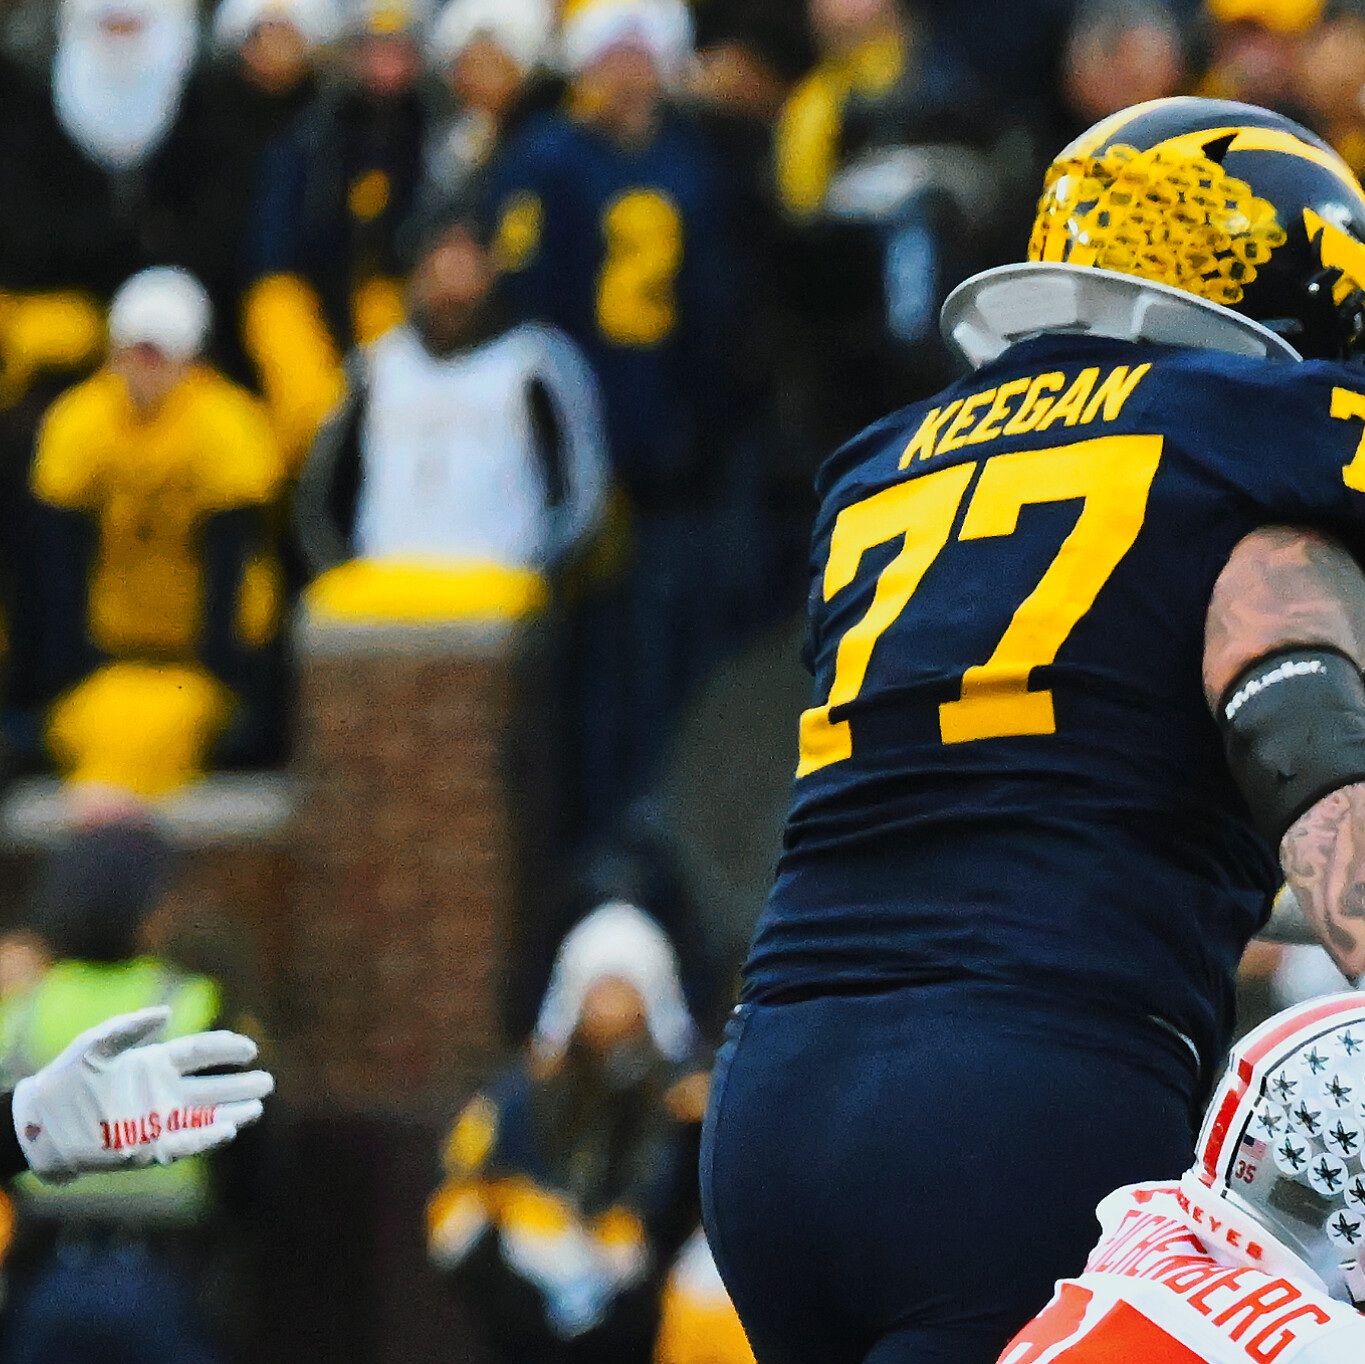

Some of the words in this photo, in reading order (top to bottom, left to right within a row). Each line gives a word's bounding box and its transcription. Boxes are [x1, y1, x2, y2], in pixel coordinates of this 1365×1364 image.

[898, 362, 1153, 471] KEEGAN
[796, 434, 1164, 779] 77
[1235, 1160, 1257, 1184] 35
